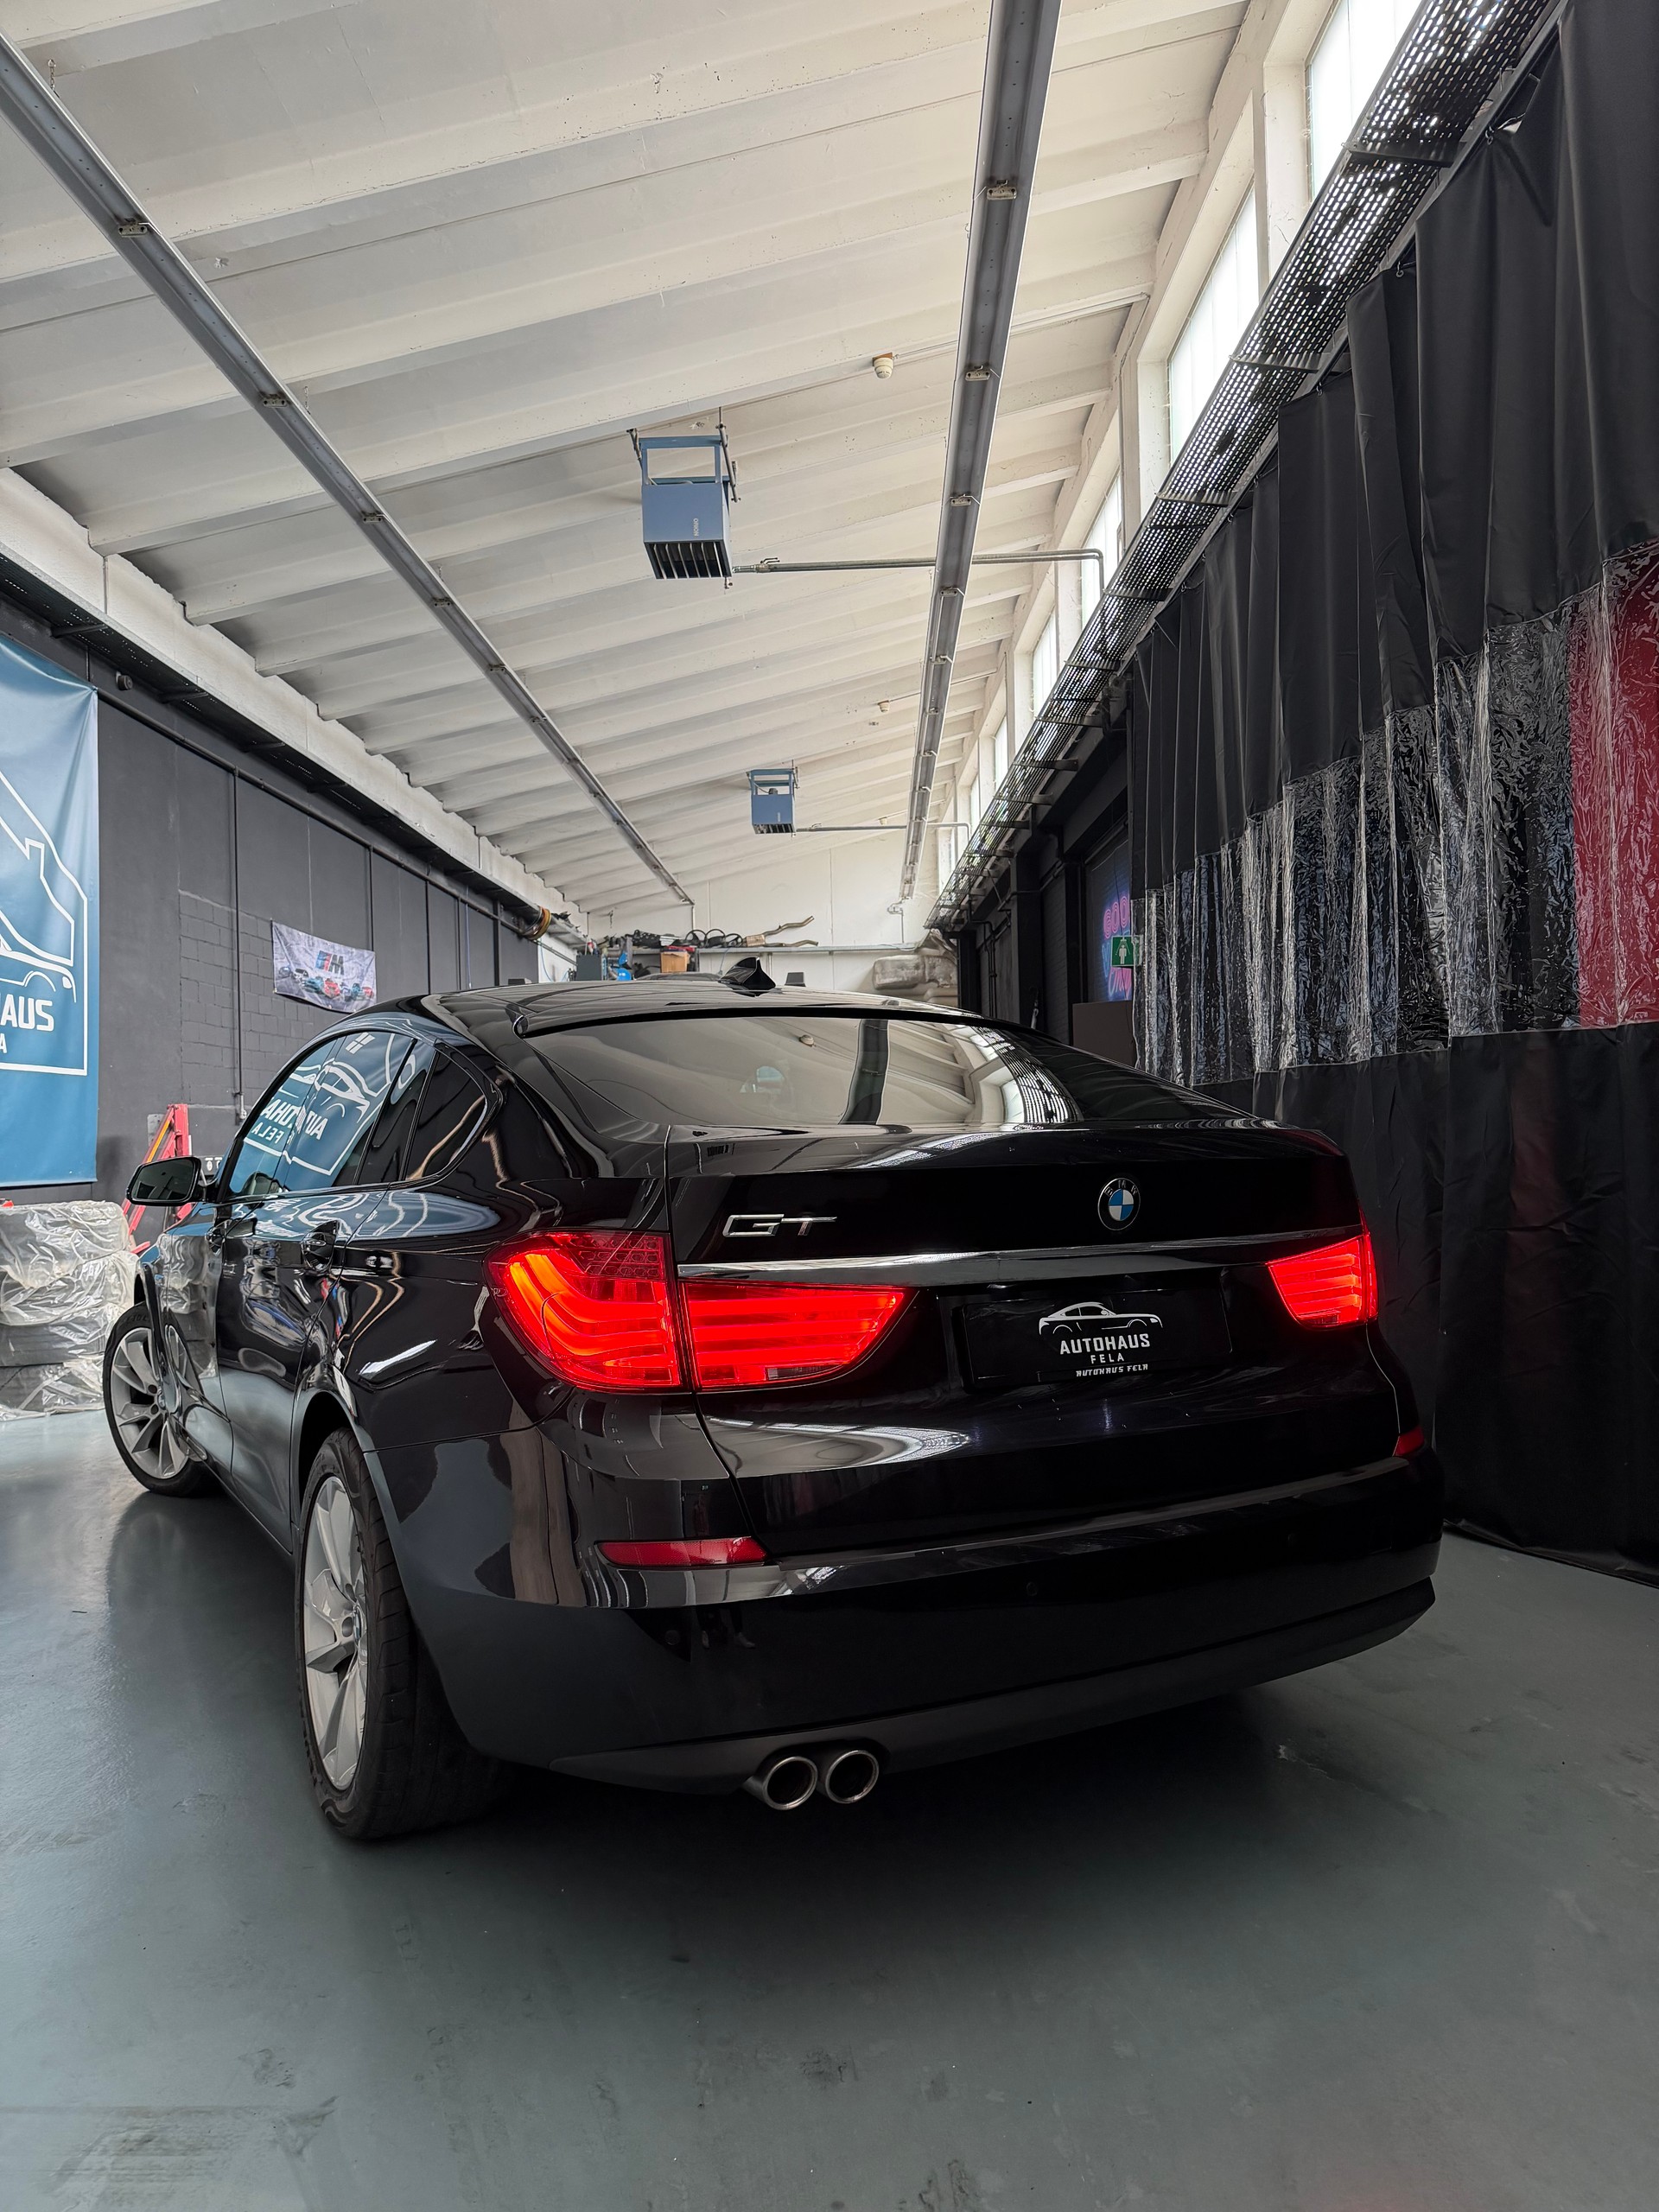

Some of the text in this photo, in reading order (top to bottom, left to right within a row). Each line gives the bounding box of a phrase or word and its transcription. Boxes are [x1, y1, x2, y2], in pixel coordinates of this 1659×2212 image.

[1103, 896, 1130, 939] GOO
[0, 993, 54, 1032] AUS
[722, 1214, 837, 1237] GT
[1059, 1333, 1150, 1355] AUTOHAUS
[1090, 1352, 1124, 1364] FELA
[1076, 1363, 1148, 1377] AUTOHAUS FELA
